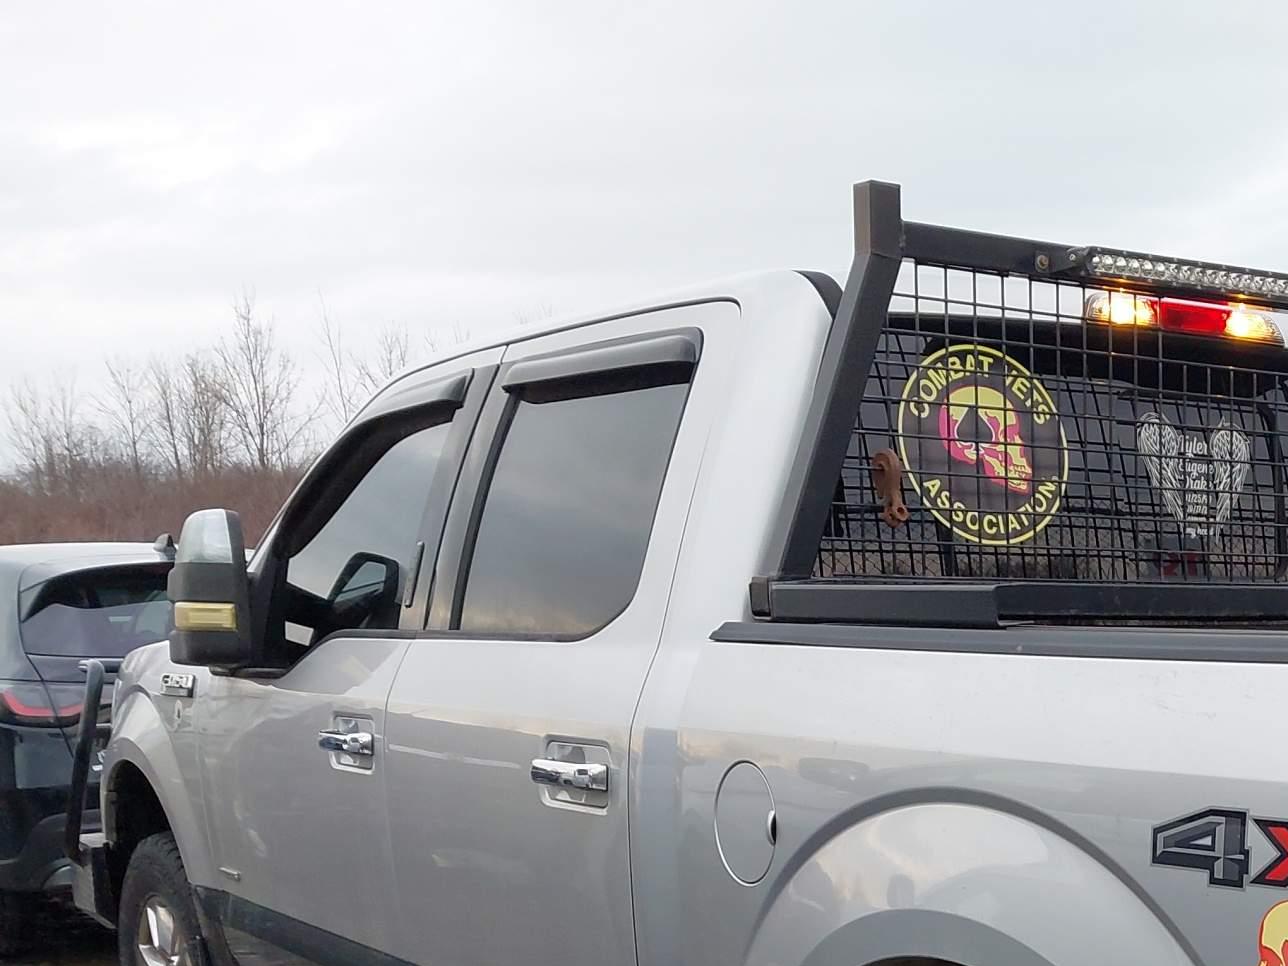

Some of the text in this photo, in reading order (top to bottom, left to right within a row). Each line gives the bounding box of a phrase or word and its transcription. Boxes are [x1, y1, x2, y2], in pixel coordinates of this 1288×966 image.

[909, 354, 1051, 425] COMBAT VETS
[923, 478, 1059, 535] ASSOCIATION
